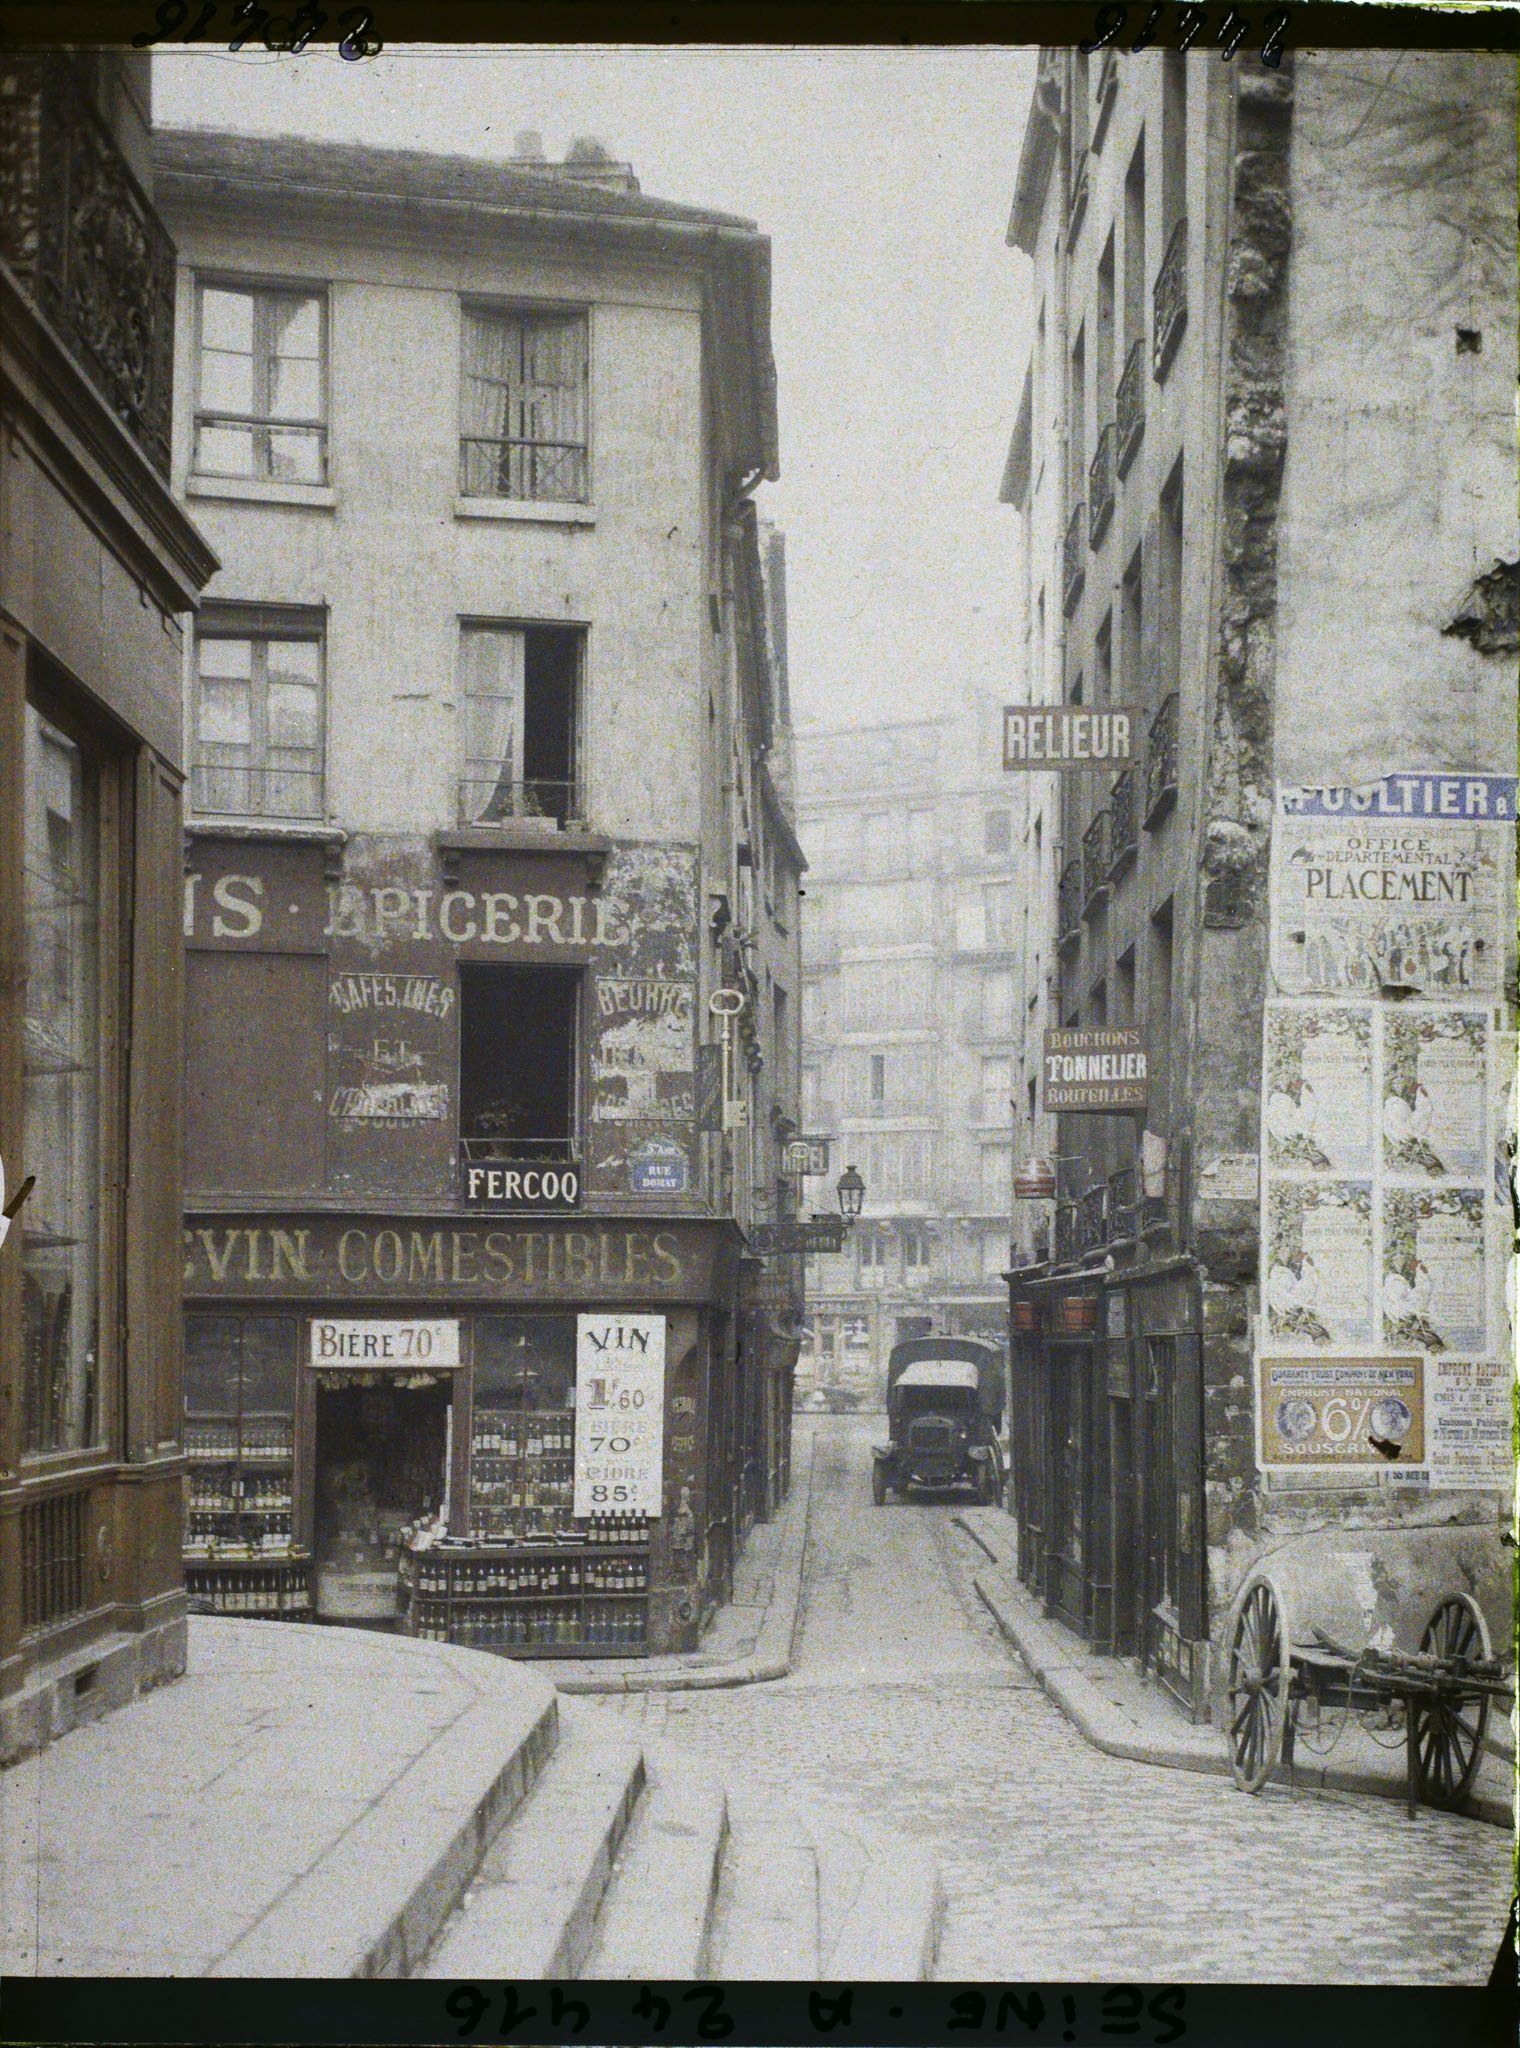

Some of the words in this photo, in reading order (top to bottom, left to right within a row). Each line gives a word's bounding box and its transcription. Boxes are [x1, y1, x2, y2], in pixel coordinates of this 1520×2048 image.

[1007, 714, 1130, 759] RELIEUR
[1347, 837, 1431, 852] OFFICE
[1305, 868, 1473, 902] PLACEMENT
[323, 886, 633, 948] EPICERIE
[1049, 1030, 1141, 1049] BOUCHONS
[1045, 1052, 1148, 1083] TONNELIER
[1046, 1086, 1144, 1104] BOUTEILLES
[468, 1167, 579, 1205] FERCOQ
[648, 1165, 672, 1176] RUE
[203, 1228, 312, 1280] VIN
[336, 1228, 684, 1284] COMESTIBLES
[586, 1328, 652, 1356] VIN
